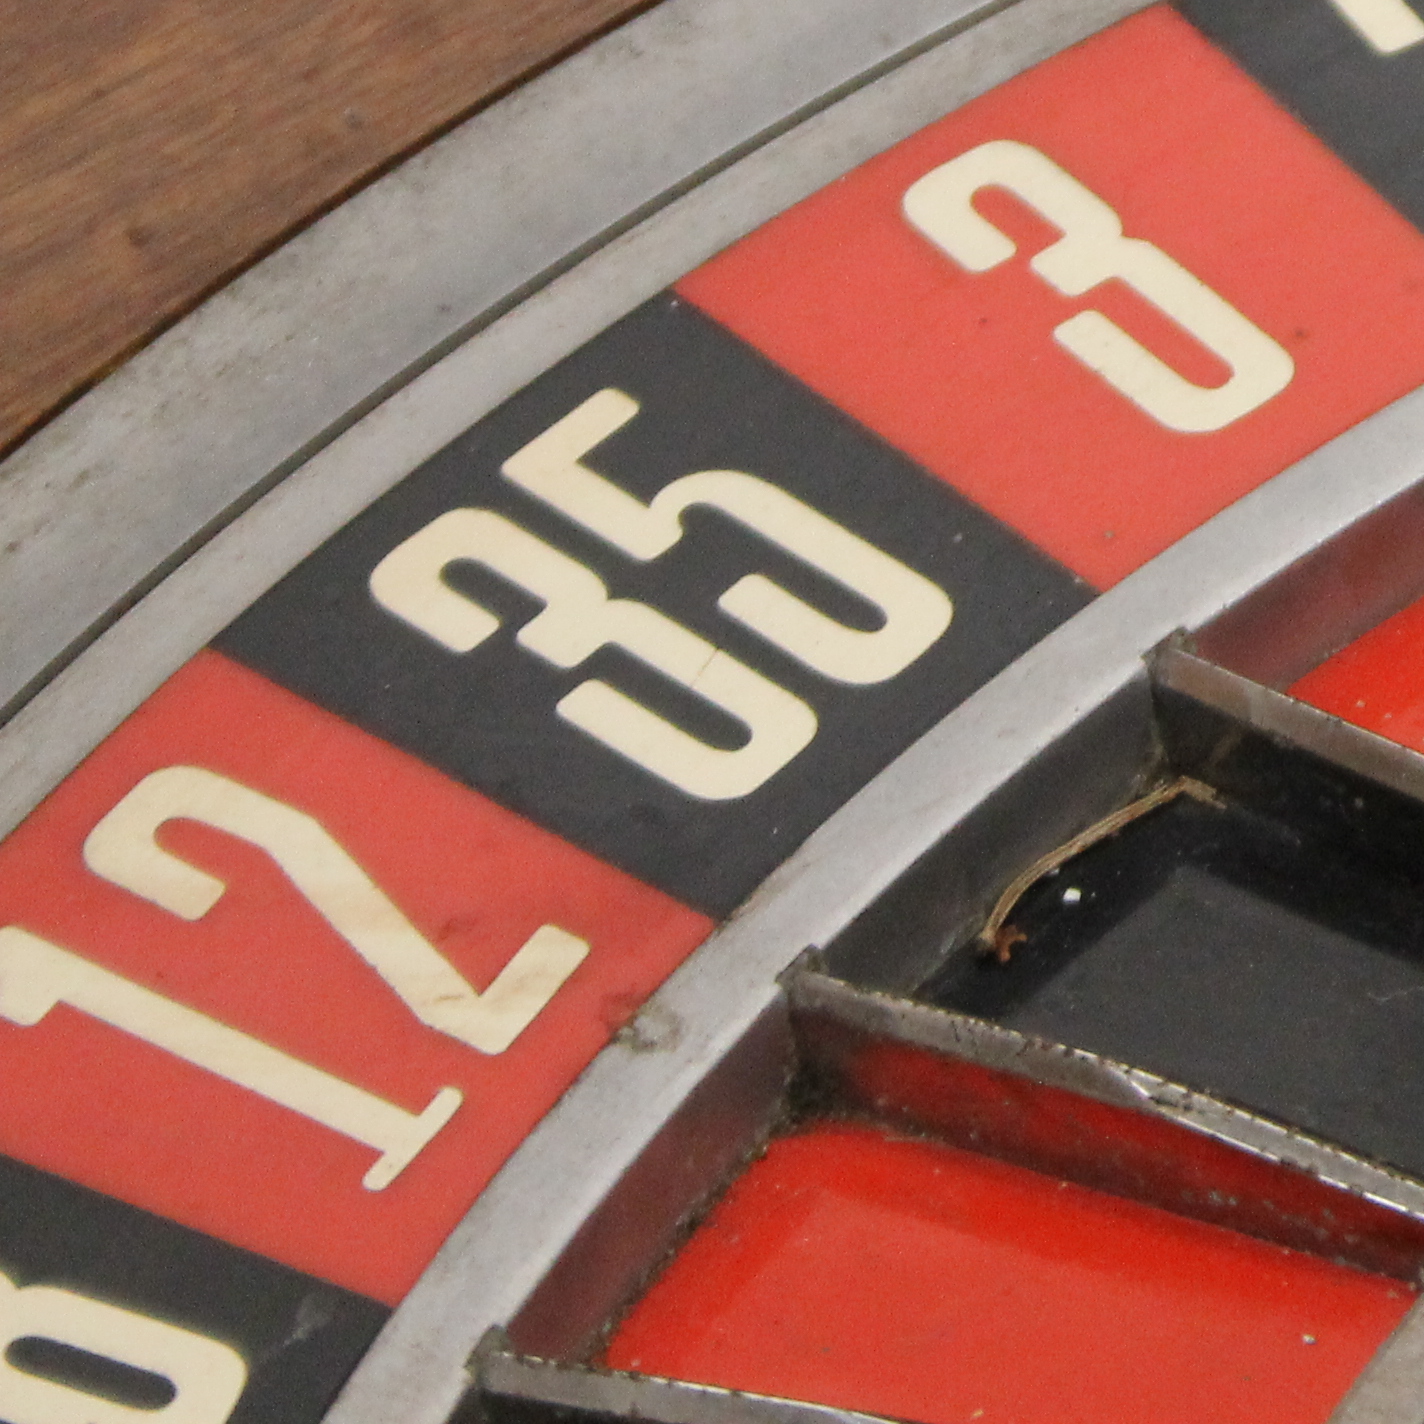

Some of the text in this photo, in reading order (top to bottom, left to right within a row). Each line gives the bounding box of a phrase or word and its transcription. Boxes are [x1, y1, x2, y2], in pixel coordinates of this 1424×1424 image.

[902, 141, 1294, 434] 3
[370, 390, 952, 800] 35
[0, 765, 589, 1191] 12
